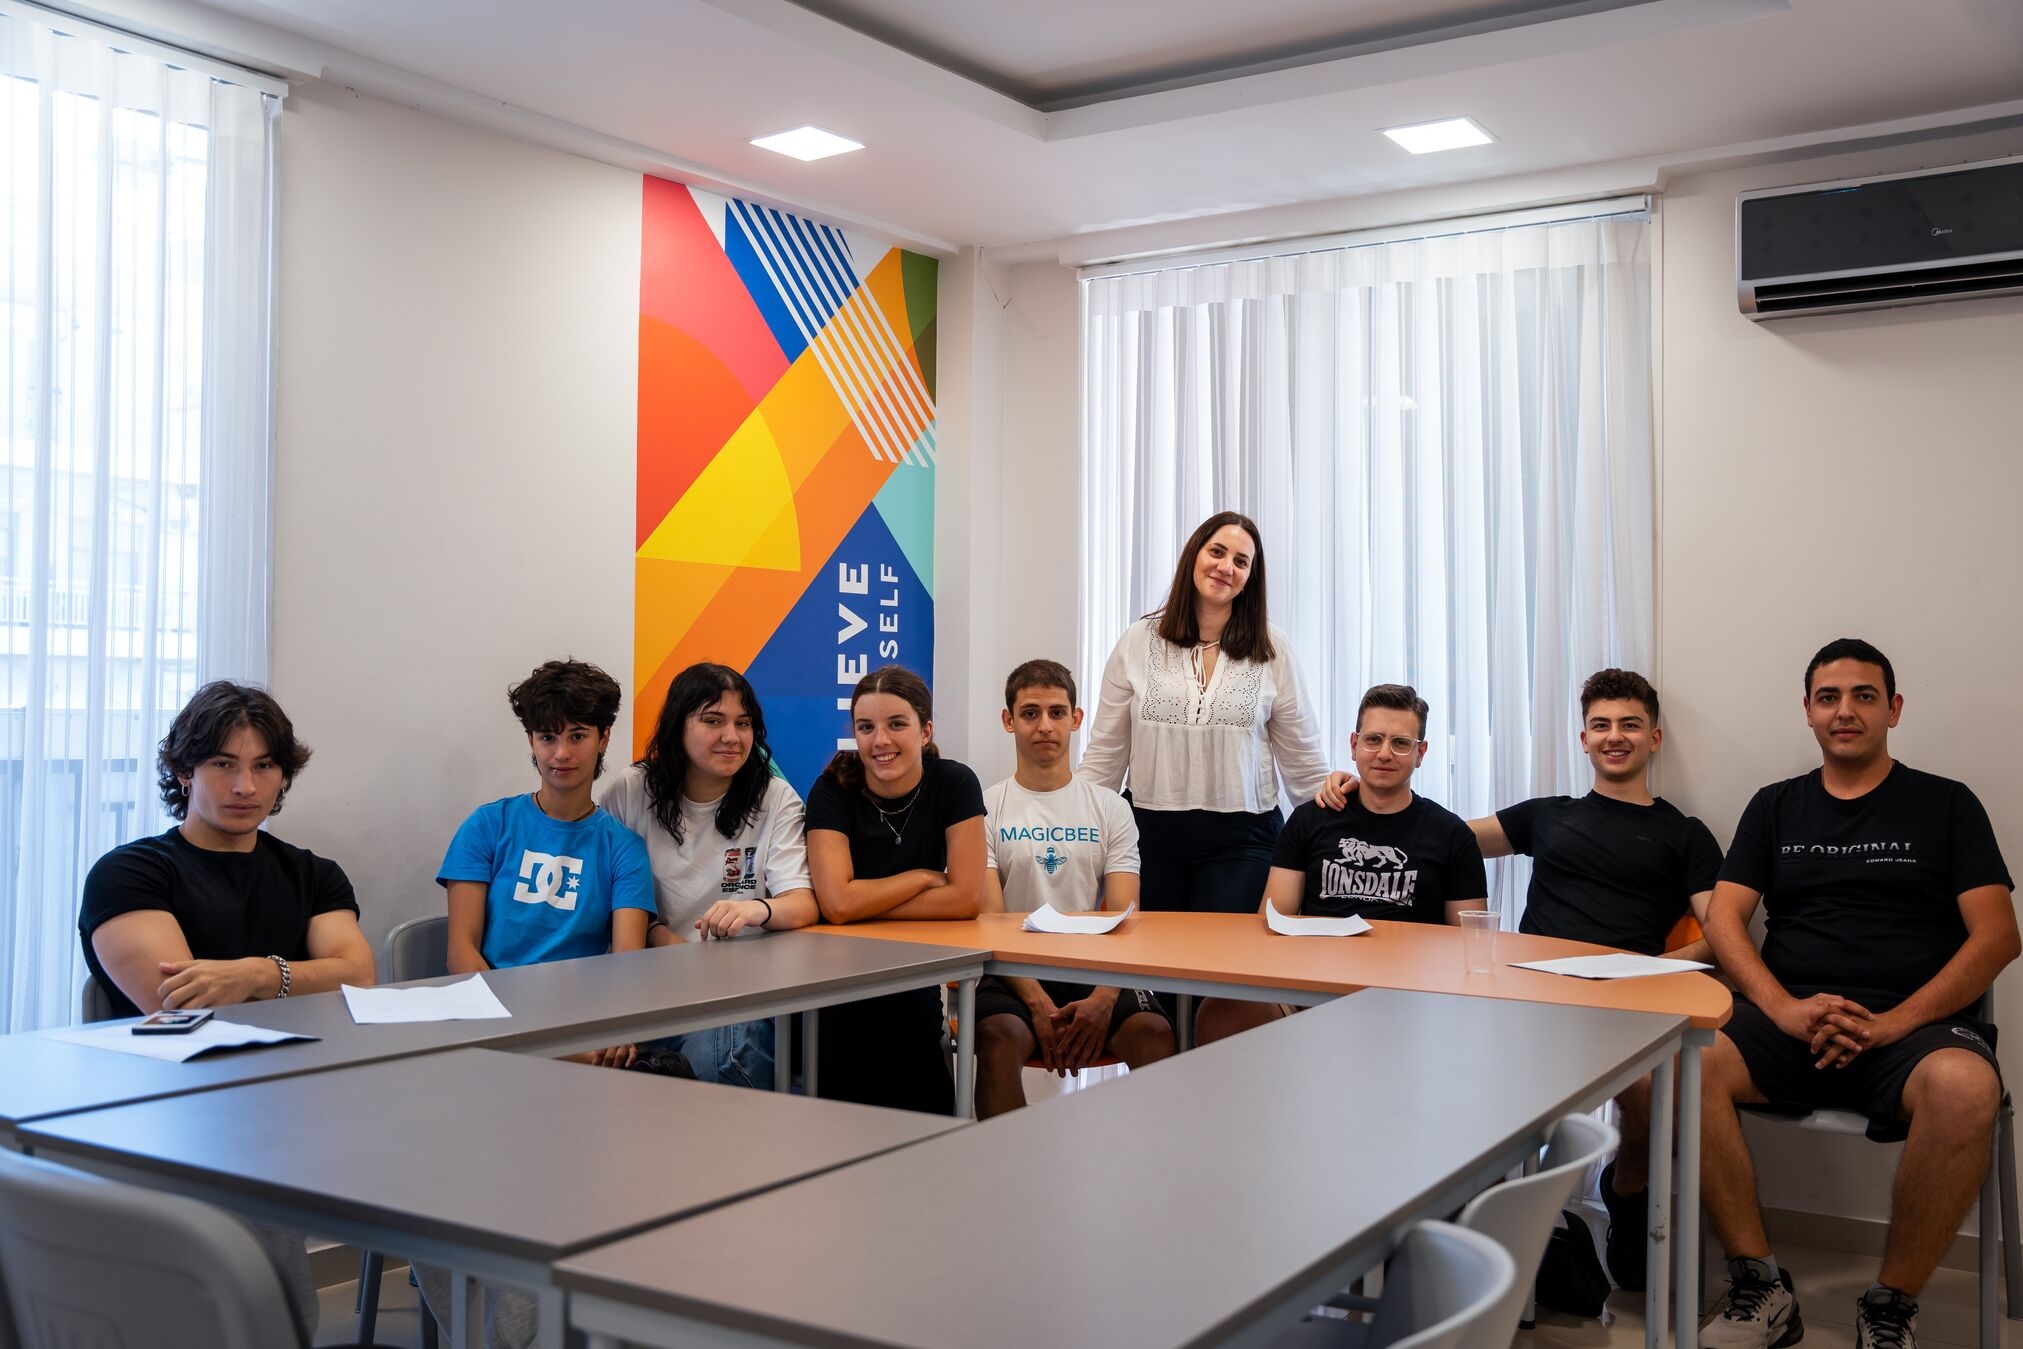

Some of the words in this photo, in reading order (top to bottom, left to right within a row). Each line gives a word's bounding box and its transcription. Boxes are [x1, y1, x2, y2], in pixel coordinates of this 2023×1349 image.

[879, 563, 899, 659] SELF
[1000, 826, 1100, 843] MAGICBEE
[513, 849, 583, 911] DC
[721, 879, 757, 888] ORCARD
[1319, 859, 1418, 906] LONSDALE
